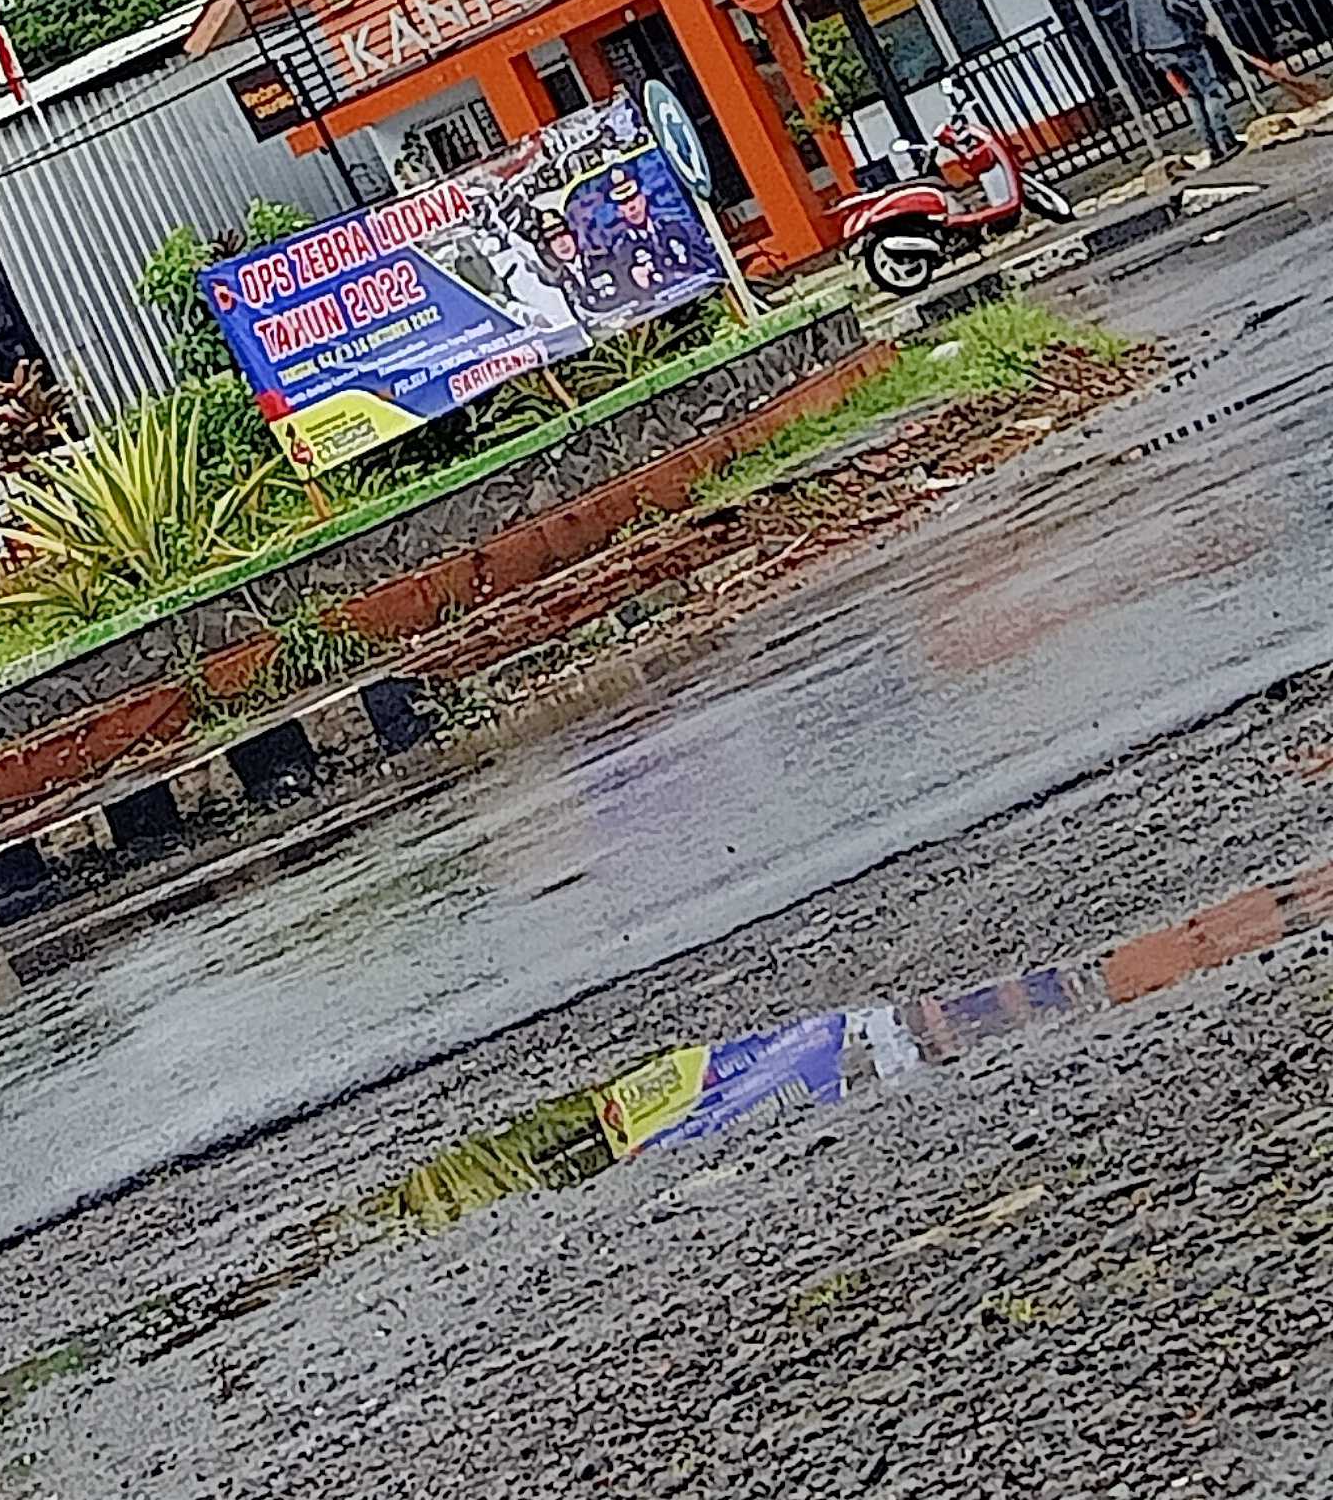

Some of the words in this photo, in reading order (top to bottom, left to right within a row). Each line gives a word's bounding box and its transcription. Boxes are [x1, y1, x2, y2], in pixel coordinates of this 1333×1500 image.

[238, 253, 296, 309] OPS
[288, 220, 377, 292] ZEBRA
[367, 180, 473, 252] LODAYA
[253, 292, 348, 362] TAHUN
[340, 259, 428, 331] 2022
